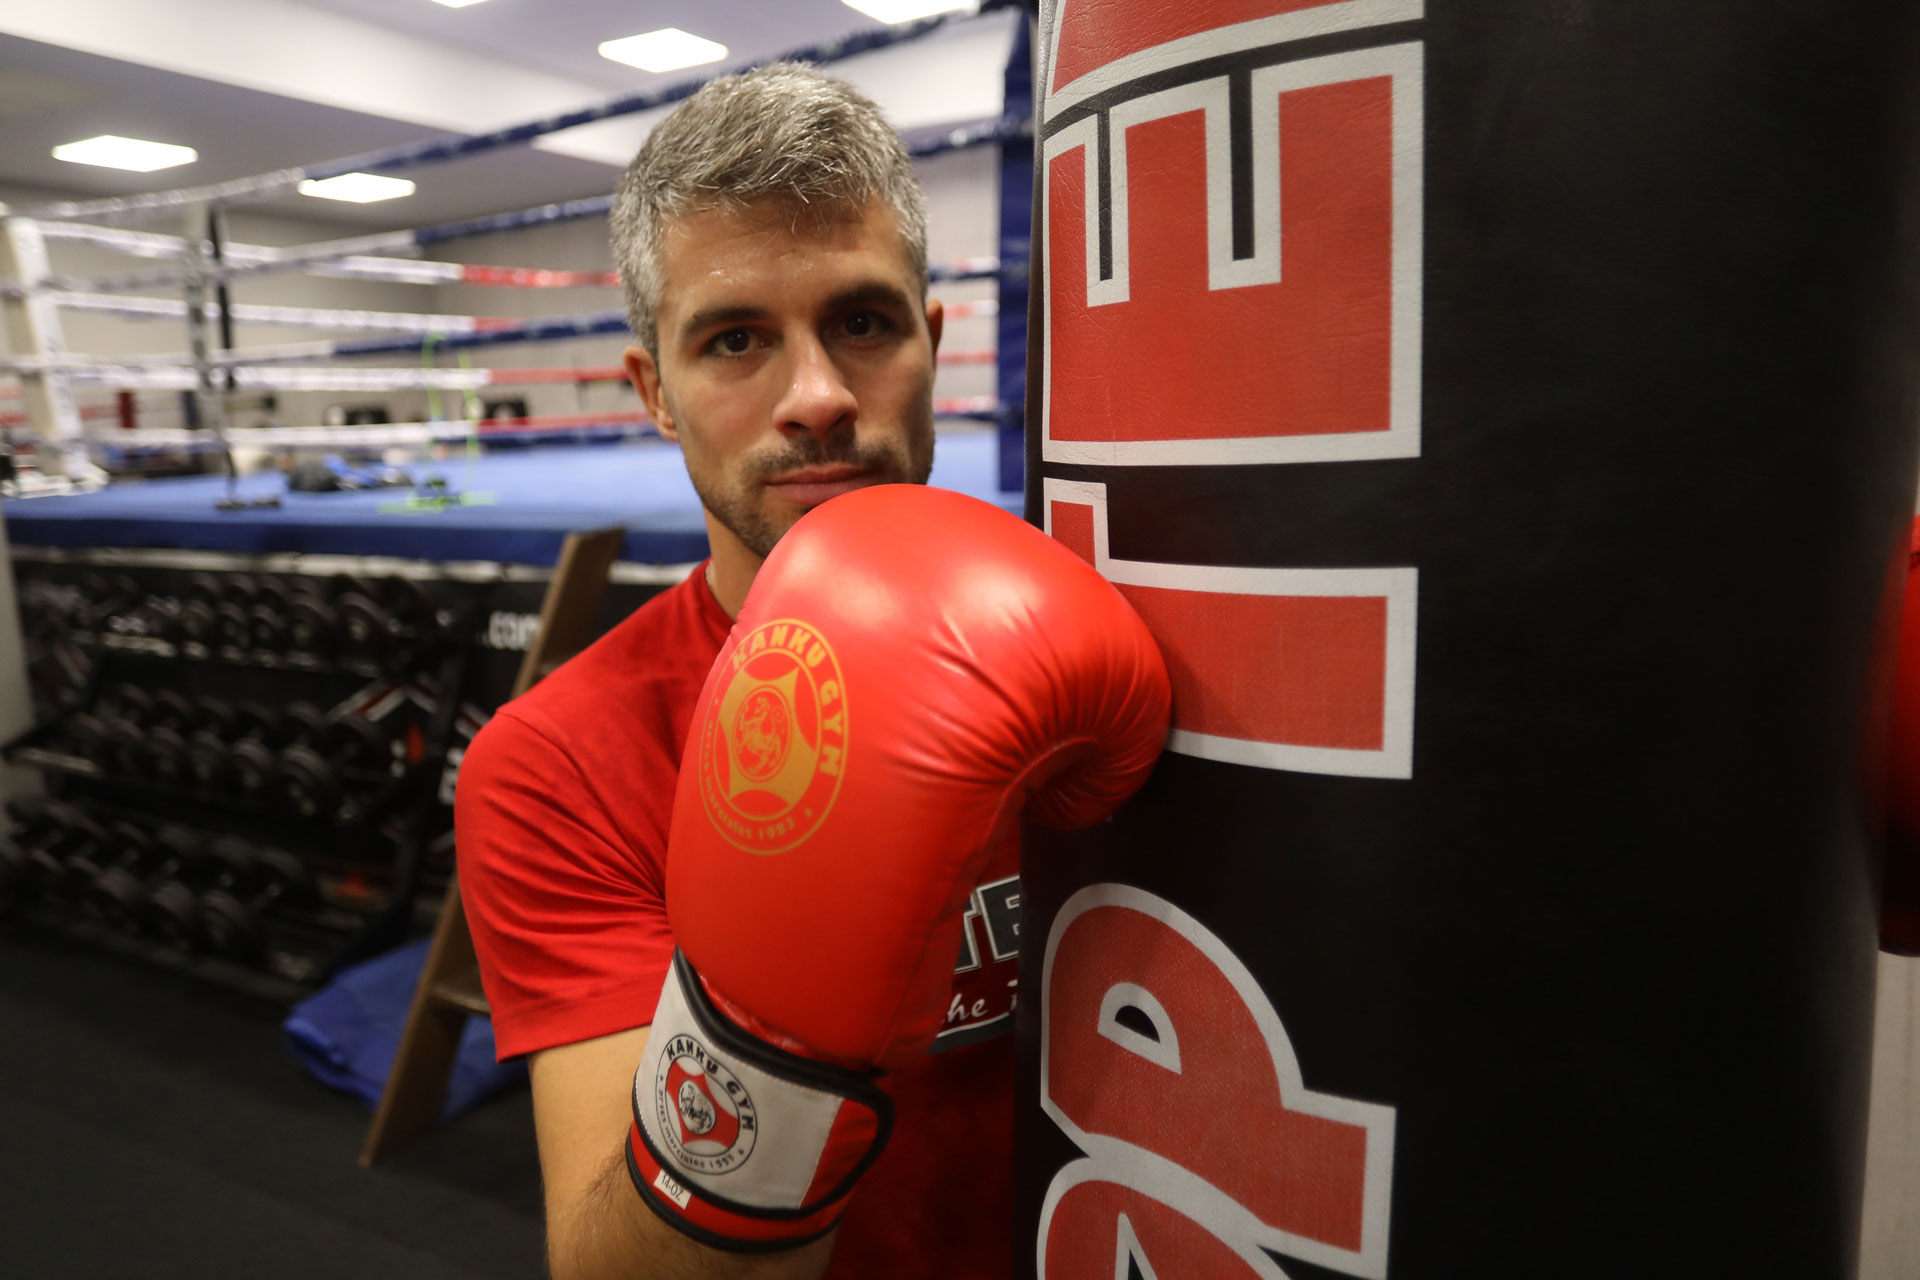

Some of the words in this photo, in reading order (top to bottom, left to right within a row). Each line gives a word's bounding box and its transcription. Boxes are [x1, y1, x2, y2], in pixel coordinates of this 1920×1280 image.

[733, 625, 827, 672] KANKU
[820, 679, 844, 777] GYM
[666, 1039, 719, 1075] KANKU
[726, 1080, 754, 1132] GYM
[665, 1127, 705, 1168] marciales
